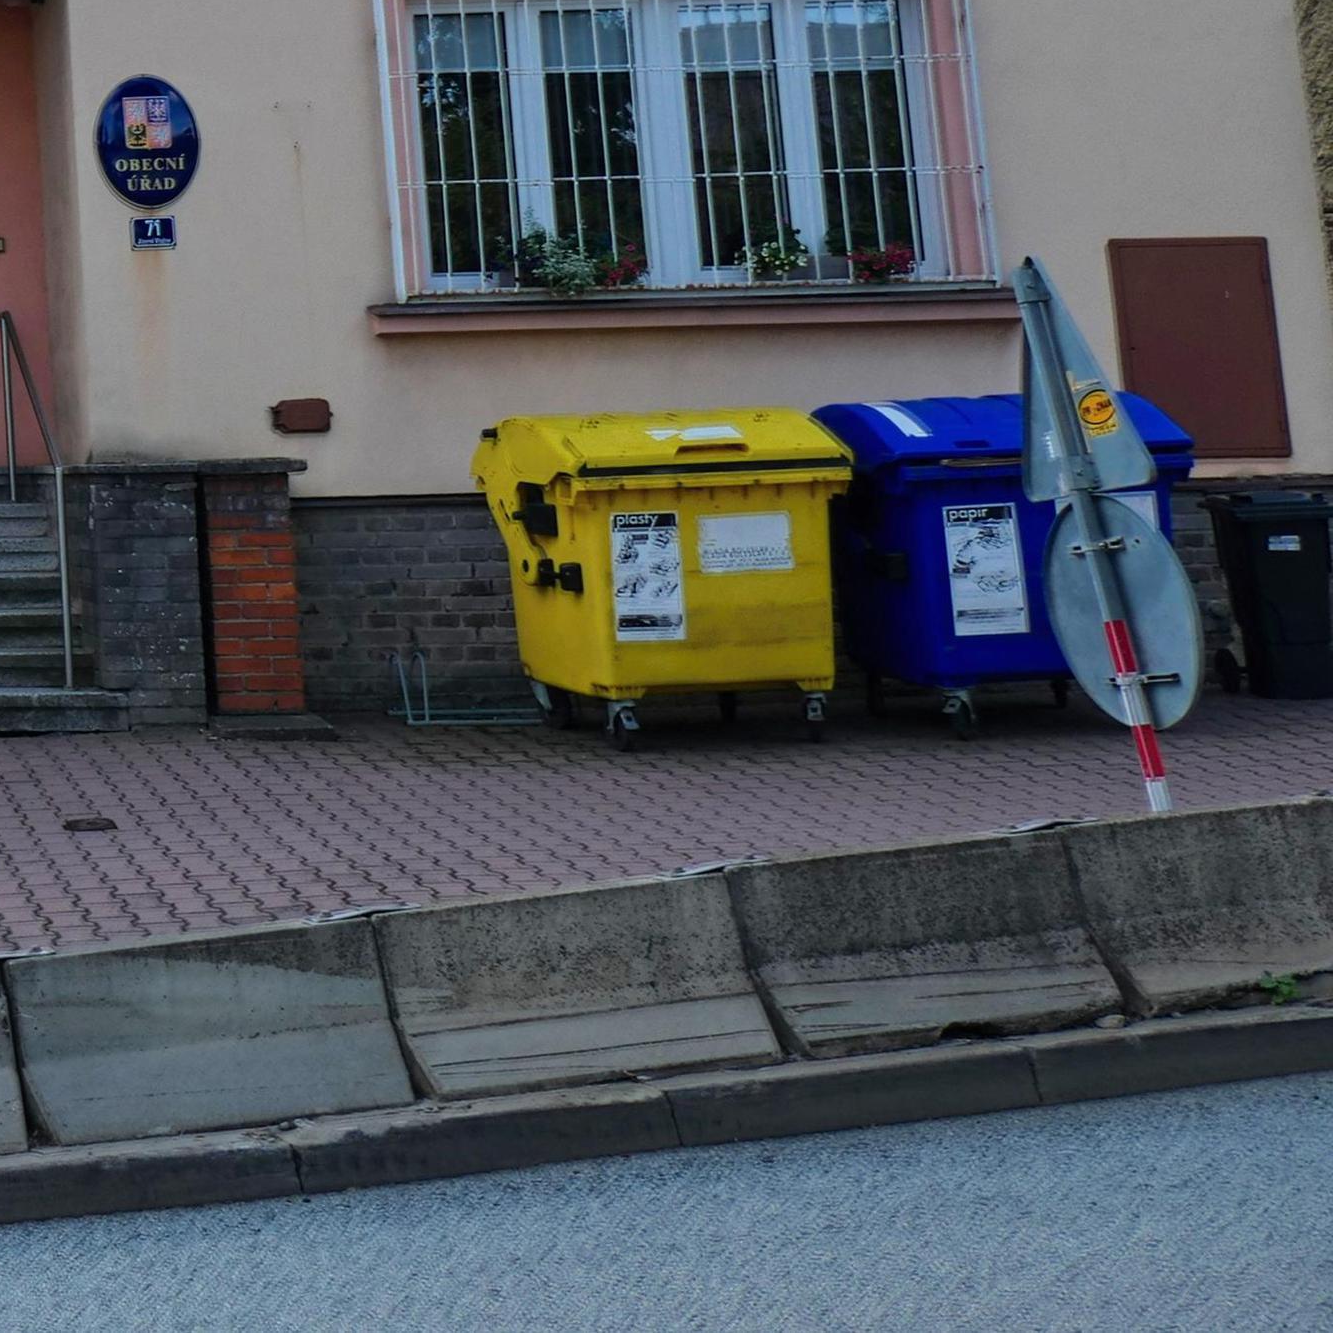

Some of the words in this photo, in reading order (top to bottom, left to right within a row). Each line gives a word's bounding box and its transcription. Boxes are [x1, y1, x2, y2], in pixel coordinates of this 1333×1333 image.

[115, 153, 186, 172] OBECNÍ
[126, 174, 176, 192] ÚŘAD
[144, 219, 161, 236] 71
[616, 514, 658, 531] plasty
